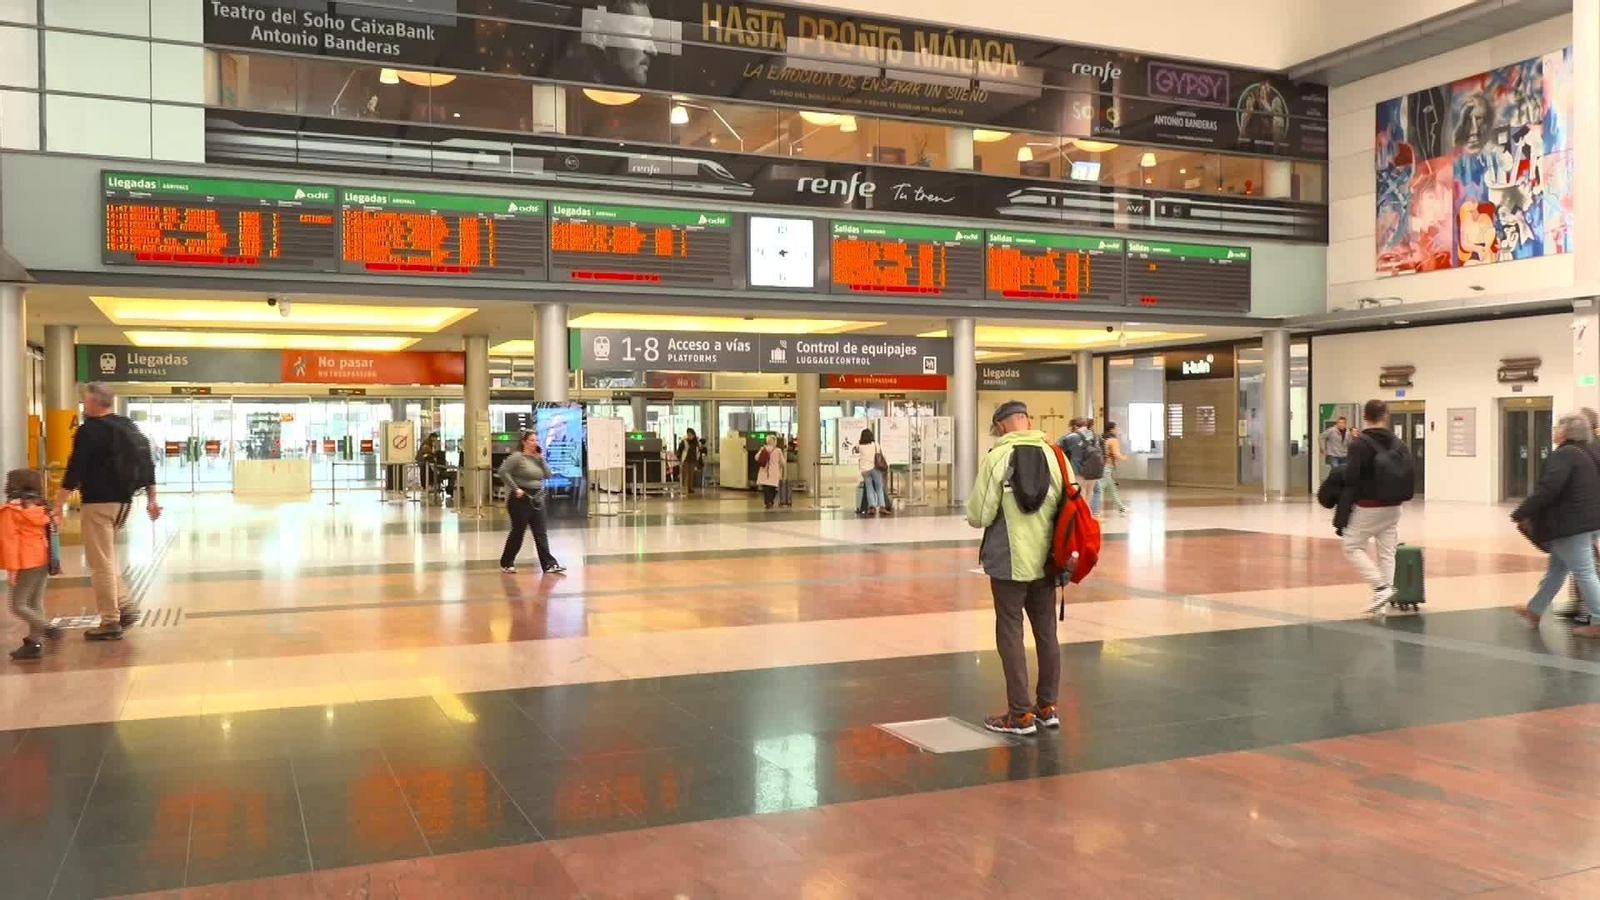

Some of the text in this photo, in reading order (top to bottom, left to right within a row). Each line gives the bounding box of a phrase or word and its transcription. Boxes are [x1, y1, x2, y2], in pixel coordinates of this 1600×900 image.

[212, 1, 435, 41] Teatro del Soho CaixaBank
[702, 2, 787, 51] HASTA
[798, 14, 903, 62] PRONTO
[251, 25, 400, 56] Antonio Banderas
[1071, 61, 1122, 84] renfe
[743, 62, 764, 79] LA
[839, 74, 858, 89] DE
[862, 79, 920, 97] ENSAYAR
[925, 83, 942, 98] UN
[1155, 69, 1223, 99] GYPSY
[1154, 114, 1218, 131] ANTONIO BANDERAS
[108, 177, 157, 190] Llegadas
[796, 171, 956, 204] renfe Tu tren
[306, 190, 329, 200] adif
[345, 192, 387, 205] Llegadas
[553, 205, 591, 217] Llegadas
[834, 224, 860, 234] Salidas
[989, 233, 1013, 243] Salidas
[1129, 242, 1150, 252] Salidas
[622, 336, 751, 362] 1-8 Acceso a vías
[796, 341, 917, 358] Control de equipajes
[127, 352, 189, 368] Llegadas
[318, 356, 375, 370] No pasar
[667, 354, 717, 363] PLATFORMS
[796, 357, 871, 366] LUGGAGE CONTROL
[128, 368, 167, 376] ARRIVALS
[983, 367, 1020, 379] Llegadas
